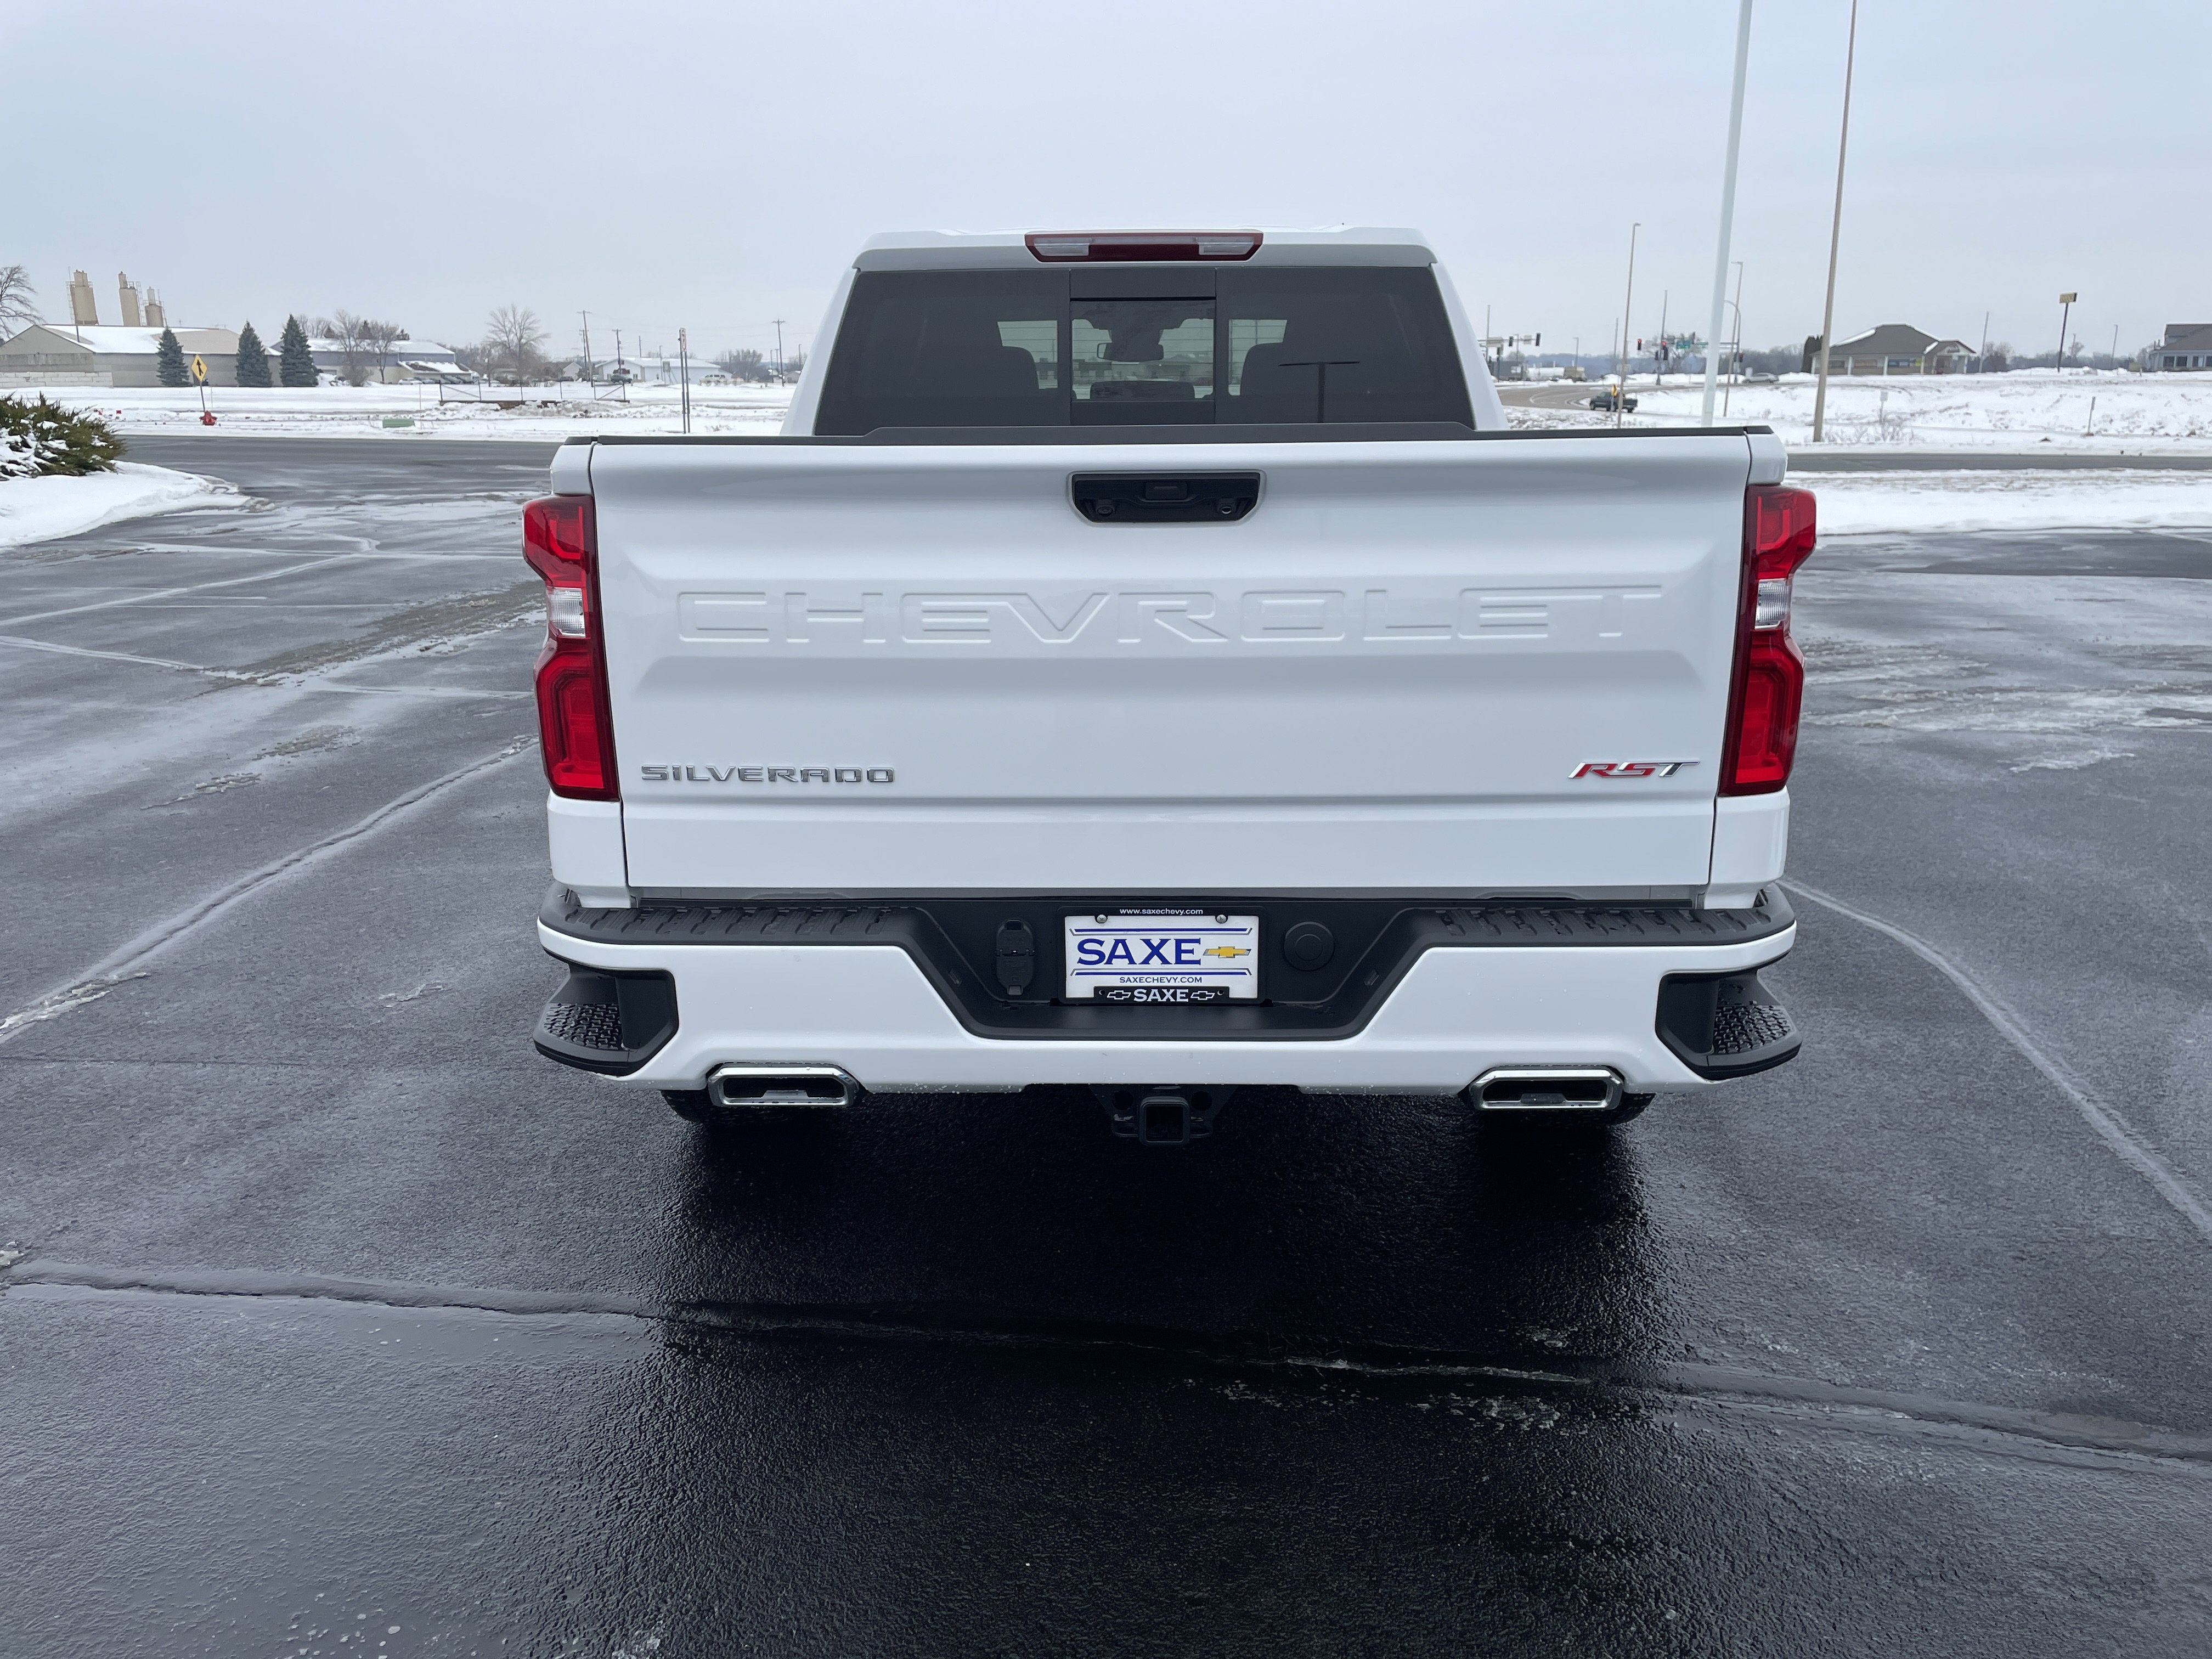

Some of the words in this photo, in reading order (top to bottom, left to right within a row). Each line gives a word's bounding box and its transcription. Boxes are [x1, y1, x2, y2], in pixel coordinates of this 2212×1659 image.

[677, 585, 1661, 643] CHEVROLET
[641, 765, 896, 783] SILVERADO
[1568, 760, 1701, 779] RST
[1119, 908, 1204, 916] www.saxechevy.com
[1077, 938, 1201, 966] SAXE
[1133, 989, 1189, 1003] SAXE
